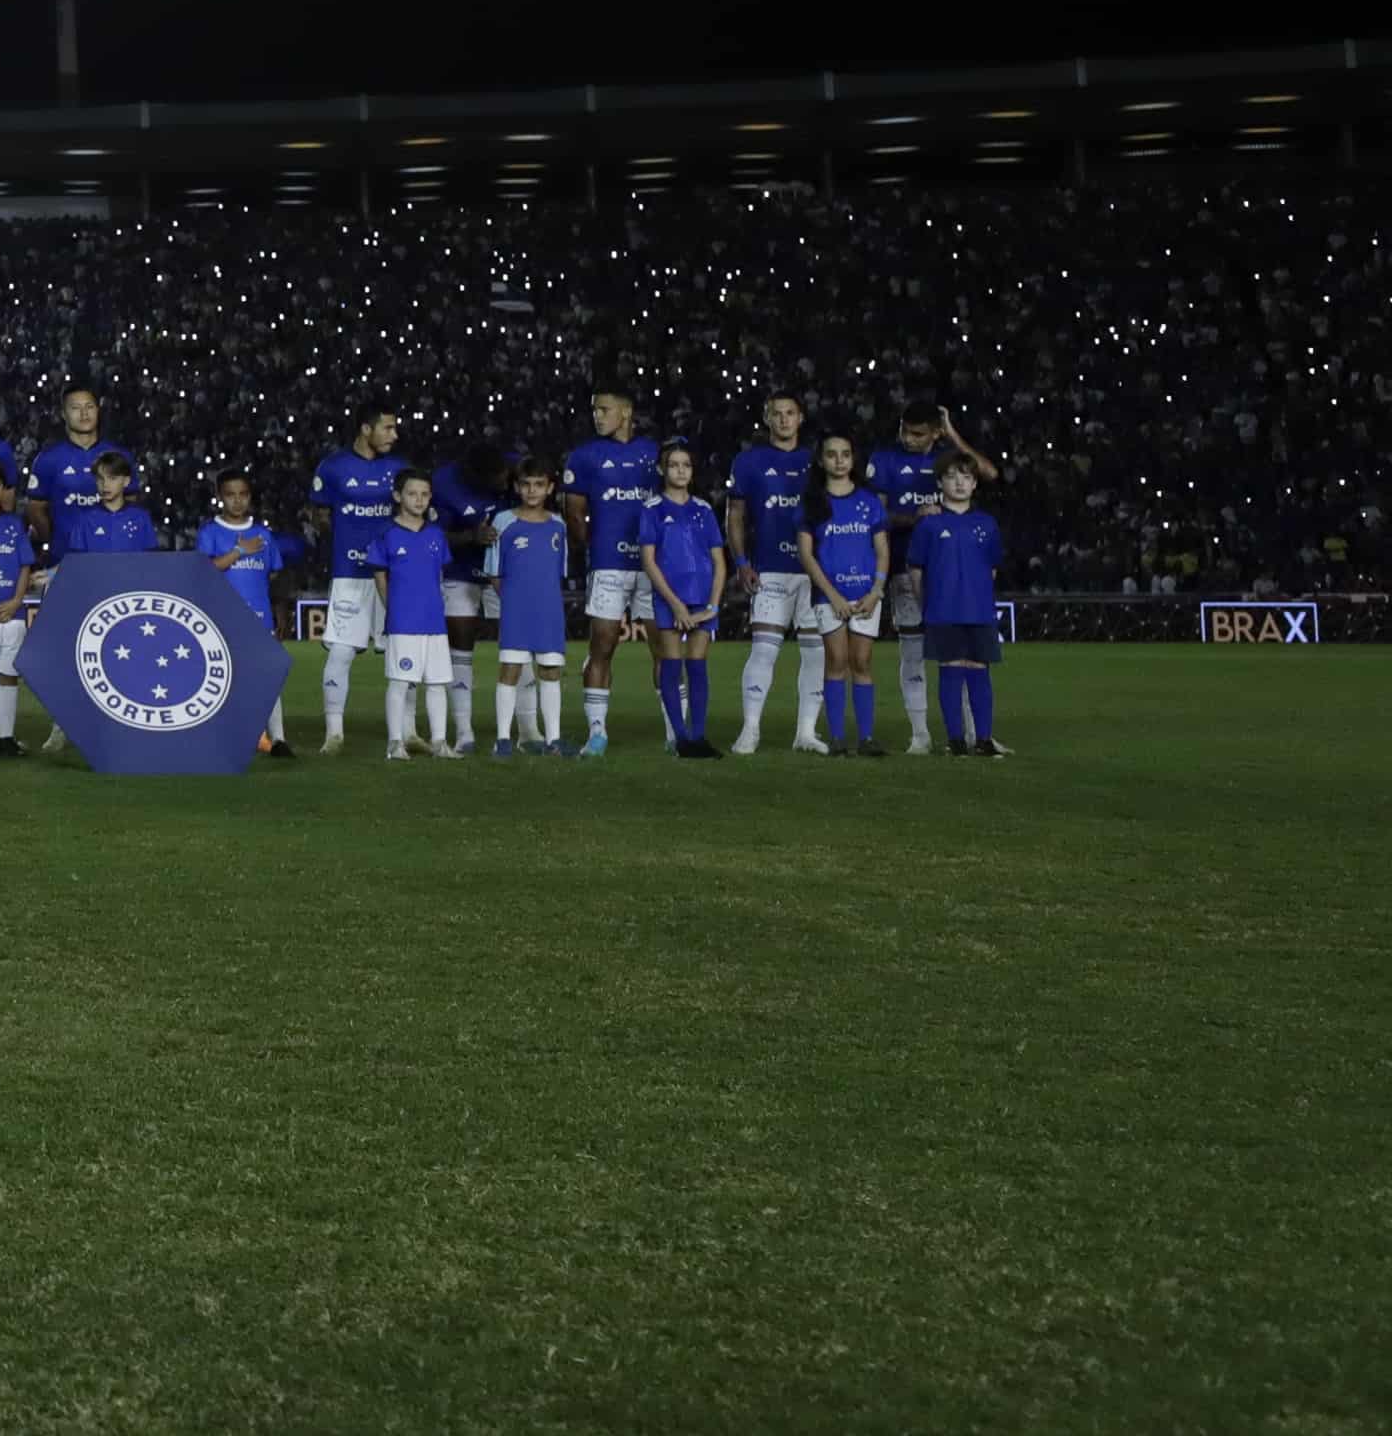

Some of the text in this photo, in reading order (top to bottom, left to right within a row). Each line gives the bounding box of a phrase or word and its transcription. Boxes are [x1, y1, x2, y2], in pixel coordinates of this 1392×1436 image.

[89, 597, 208, 637] CRUZEIRO
[1211, 611, 1308, 642] BRAX
[83, 649, 224, 724] ESPORTE CLUBE
